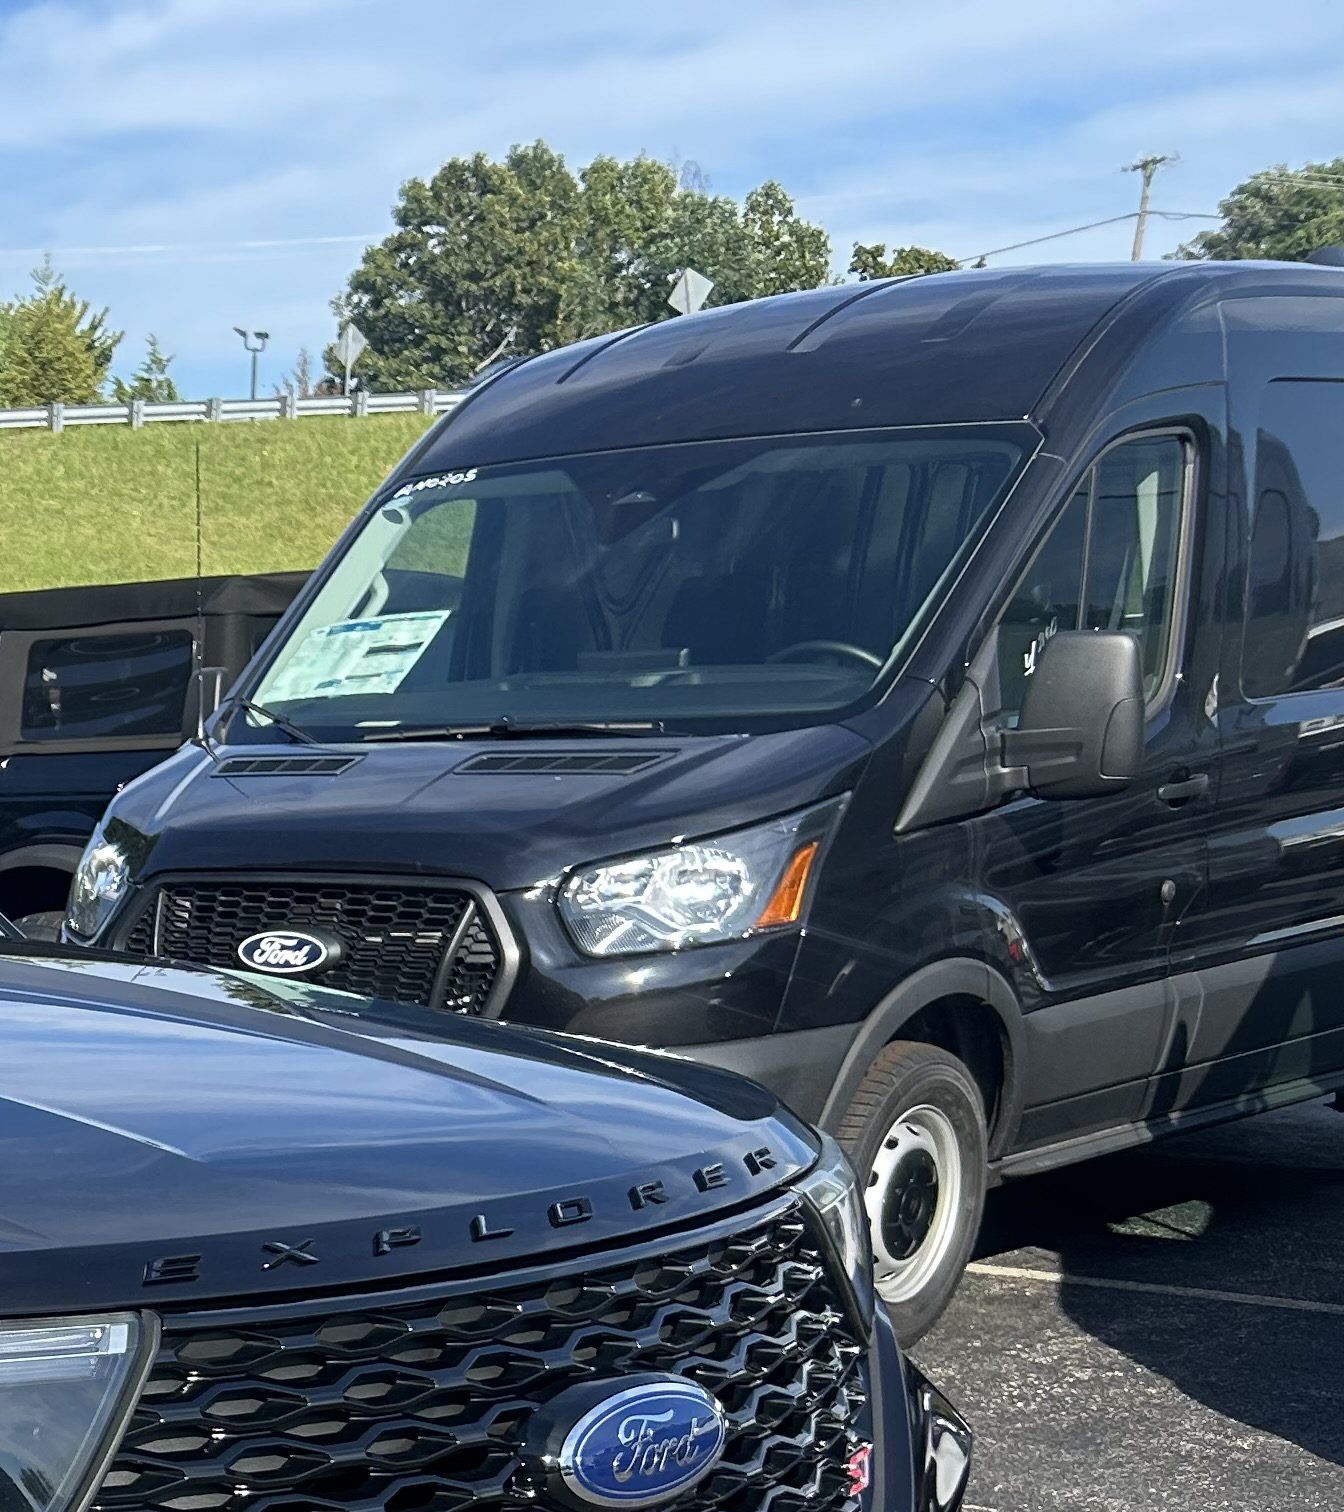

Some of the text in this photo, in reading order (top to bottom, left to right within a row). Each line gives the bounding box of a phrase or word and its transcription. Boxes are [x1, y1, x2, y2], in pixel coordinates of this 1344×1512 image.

[253, 936, 312, 966] Ford
[143, 1146, 778, 1286] EXPLORER
[612, 1407, 703, 1483] Ford
